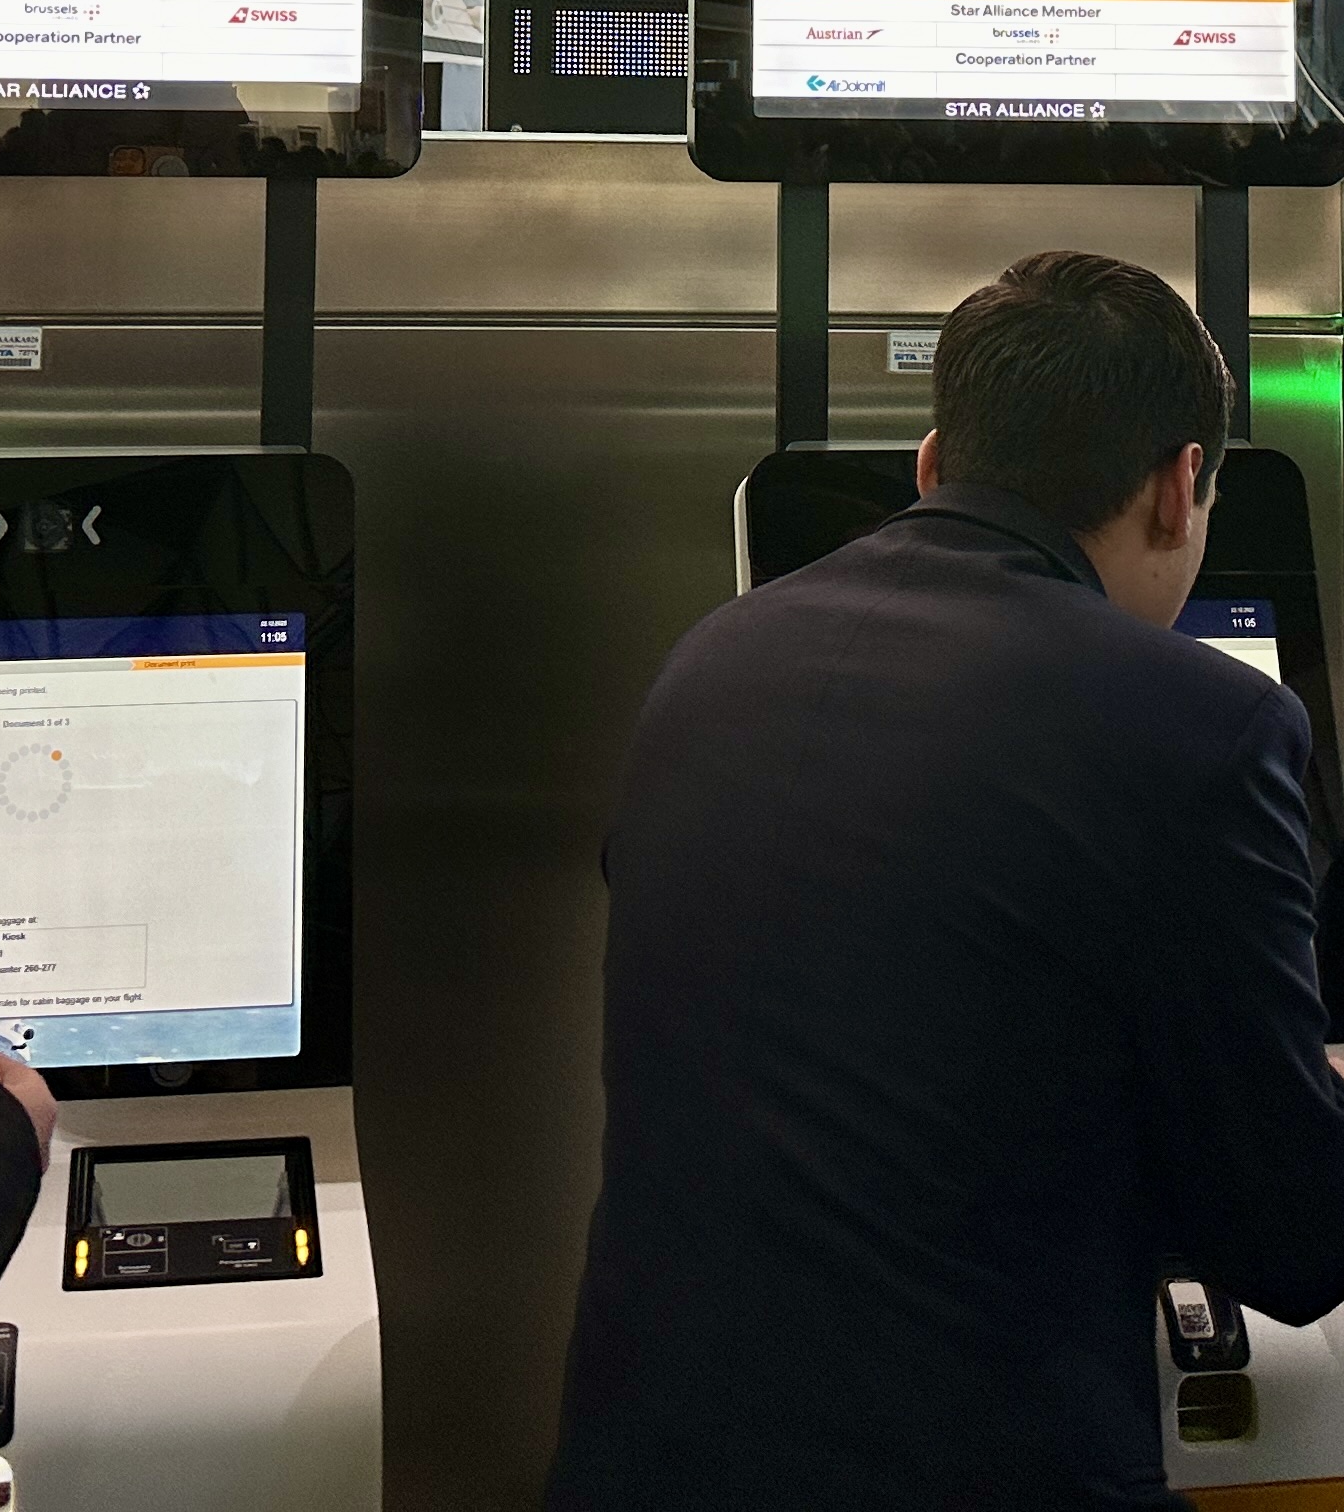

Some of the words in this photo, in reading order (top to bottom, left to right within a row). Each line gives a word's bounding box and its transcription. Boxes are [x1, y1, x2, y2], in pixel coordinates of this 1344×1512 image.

[24, 2, 79, 15] brussels
[950, 4, 980, 17] Star
[982, 5, 1039, 18] Alliance
[1041, 6, 1102, 19] Member
[250, 9, 298, 23] SWISS
[84, 31, 142, 45] Partner
[806, 26, 863, 40] Austrian
[992, 27, 1040, 39] brussels
[1193, 32, 1236, 44] SWISS
[955, 52, 1043, 68] Cooperation
[1045, 53, 1097, 67] Partner
[26, 83, 127, 99] ALLIANCE
[944, 101, 992, 117] STAR
[995, 103, 1086, 118] ALLIANCE
[893, 353, 917, 361] SITA
[260, 630, 288, 643] 11:05
[143, 660, 179, 669] Document
[180, 659, 196, 669] print
[2, 719, 45, 728] Document
[53, 718, 64, 727] of
[64, 718, 71, 726] 3
[2, 932, 26, 941] Kiosk
[19, 997, 30, 1006] for
[32, 997, 54, 1006] cabin
[55, 995, 90, 1006] baggage
[91, 995, 102, 1003] on
[104, 994, 122, 1005] your
